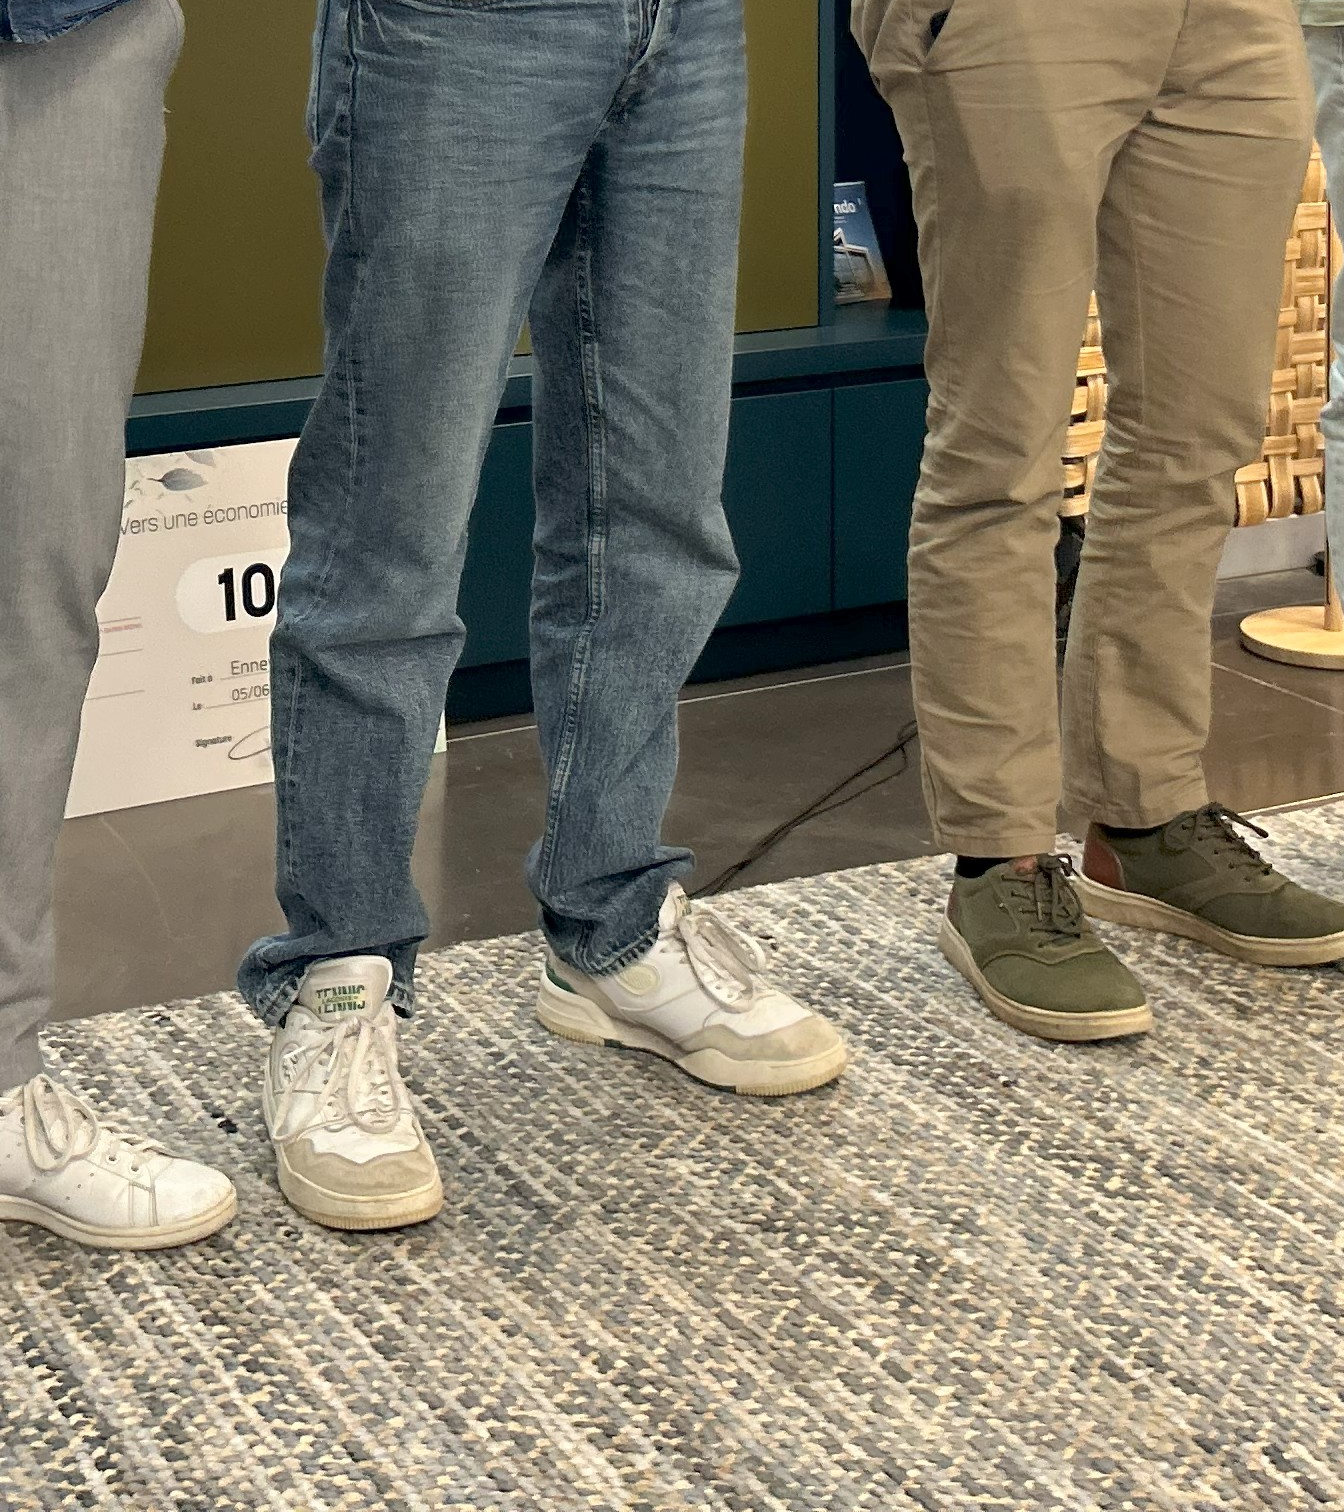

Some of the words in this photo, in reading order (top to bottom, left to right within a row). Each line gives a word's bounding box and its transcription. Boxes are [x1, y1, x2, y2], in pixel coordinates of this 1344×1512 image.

[163, 511, 198, 530] une
[204, 497, 288, 525] économie
[231, 659, 270, 675] Enne
